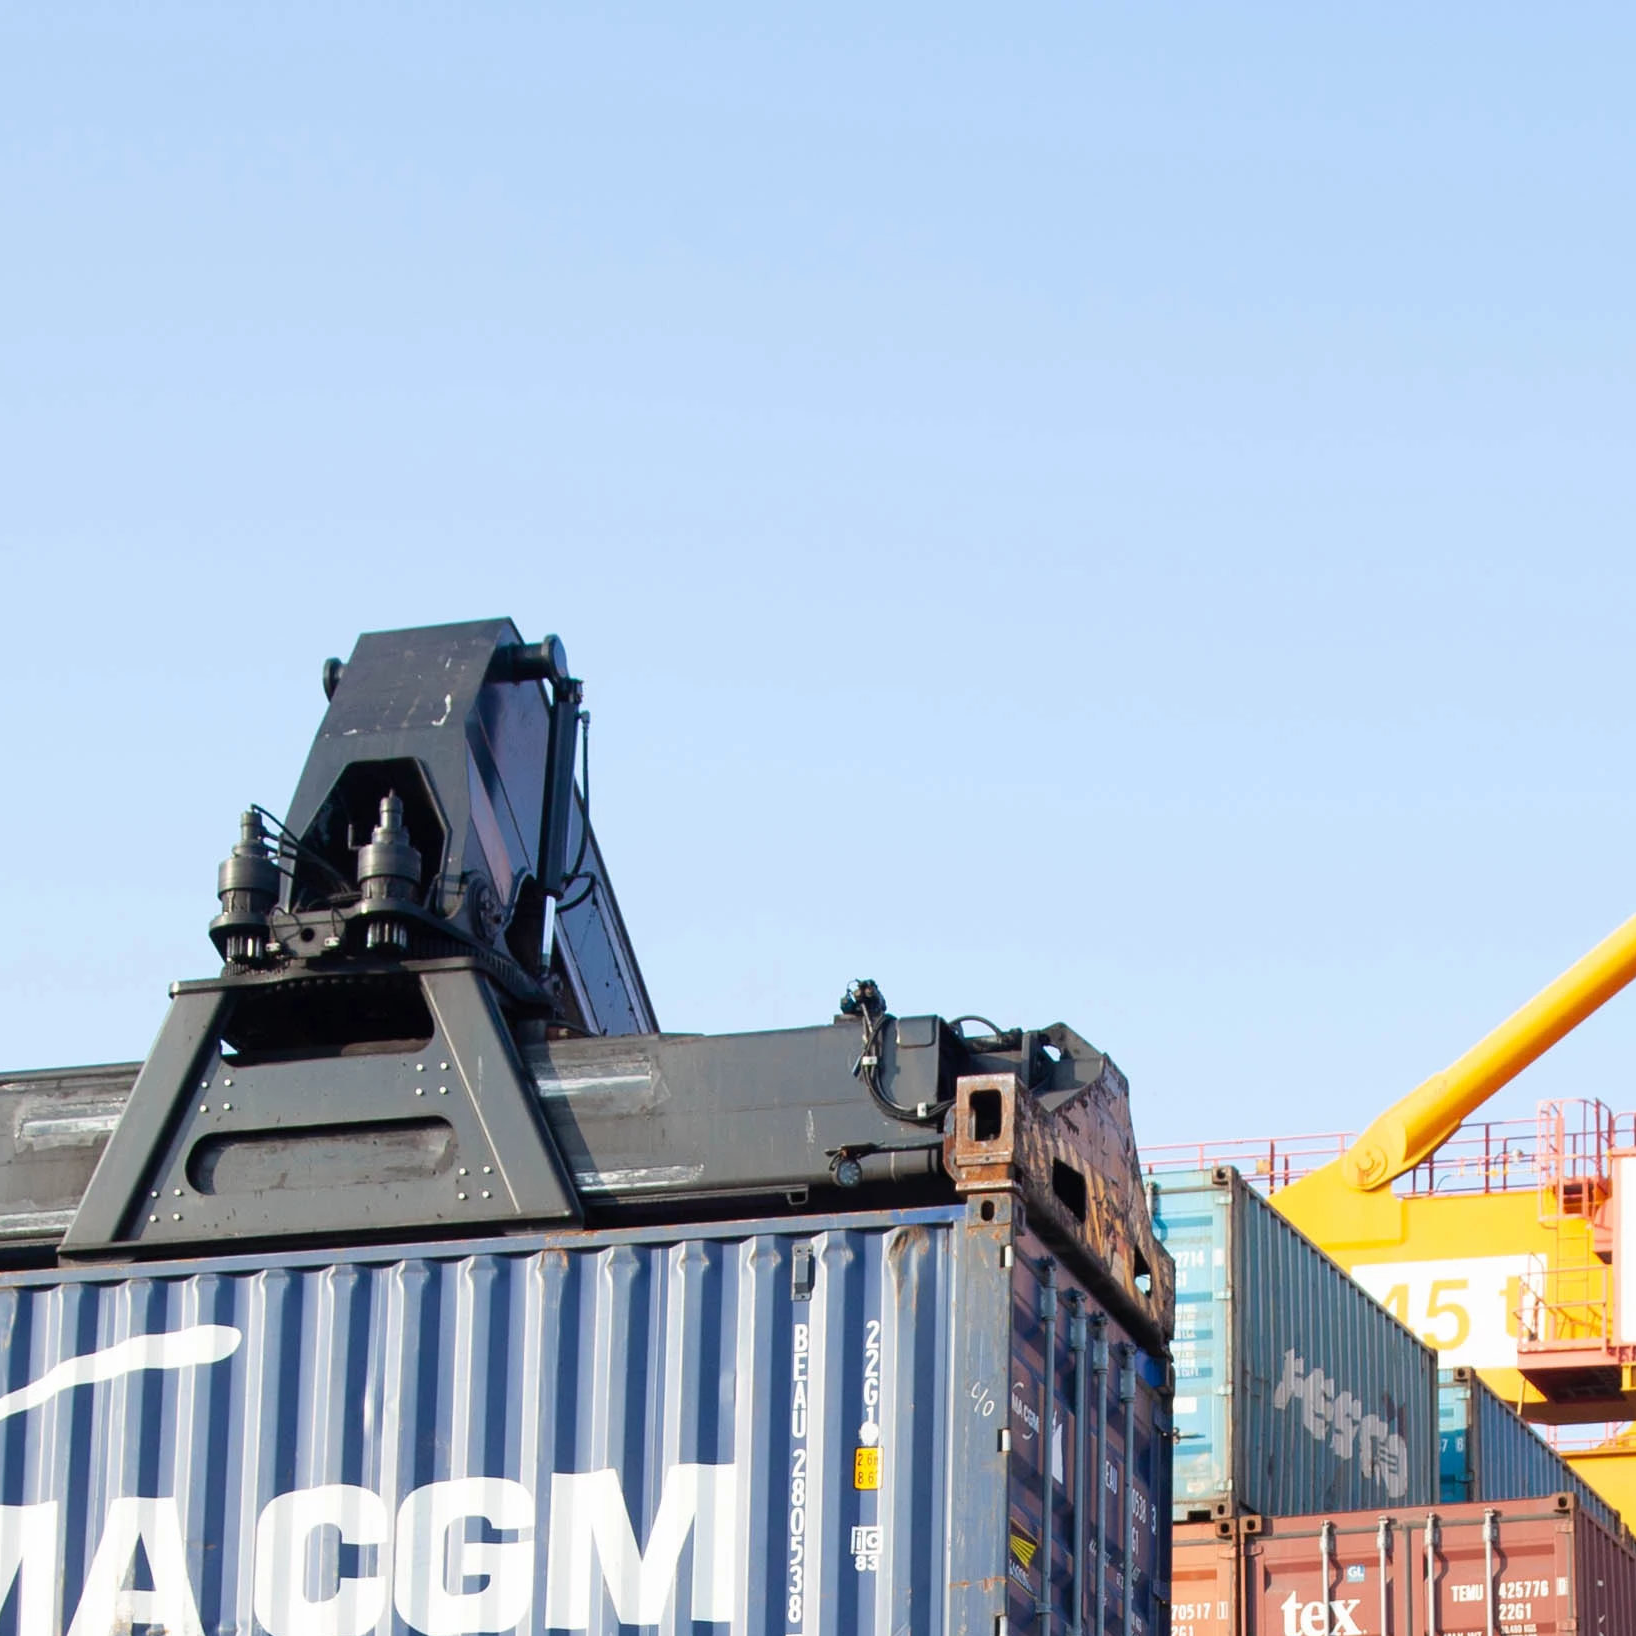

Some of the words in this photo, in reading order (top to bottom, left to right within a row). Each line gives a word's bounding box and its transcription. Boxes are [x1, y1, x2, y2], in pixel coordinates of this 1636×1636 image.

[792, 1324, 808, 1438] BEAU
[864, 1320, 880, 1424] 22G1
[788, 1449, 806, 1623] 280538
[855, 1555, 879, 1572] 83
[1451, 1584, 1483, 1602] TEMU
[1171, 1602, 1212, 1621] 70517
[1499, 1603, 1531, 1620] 22G1
